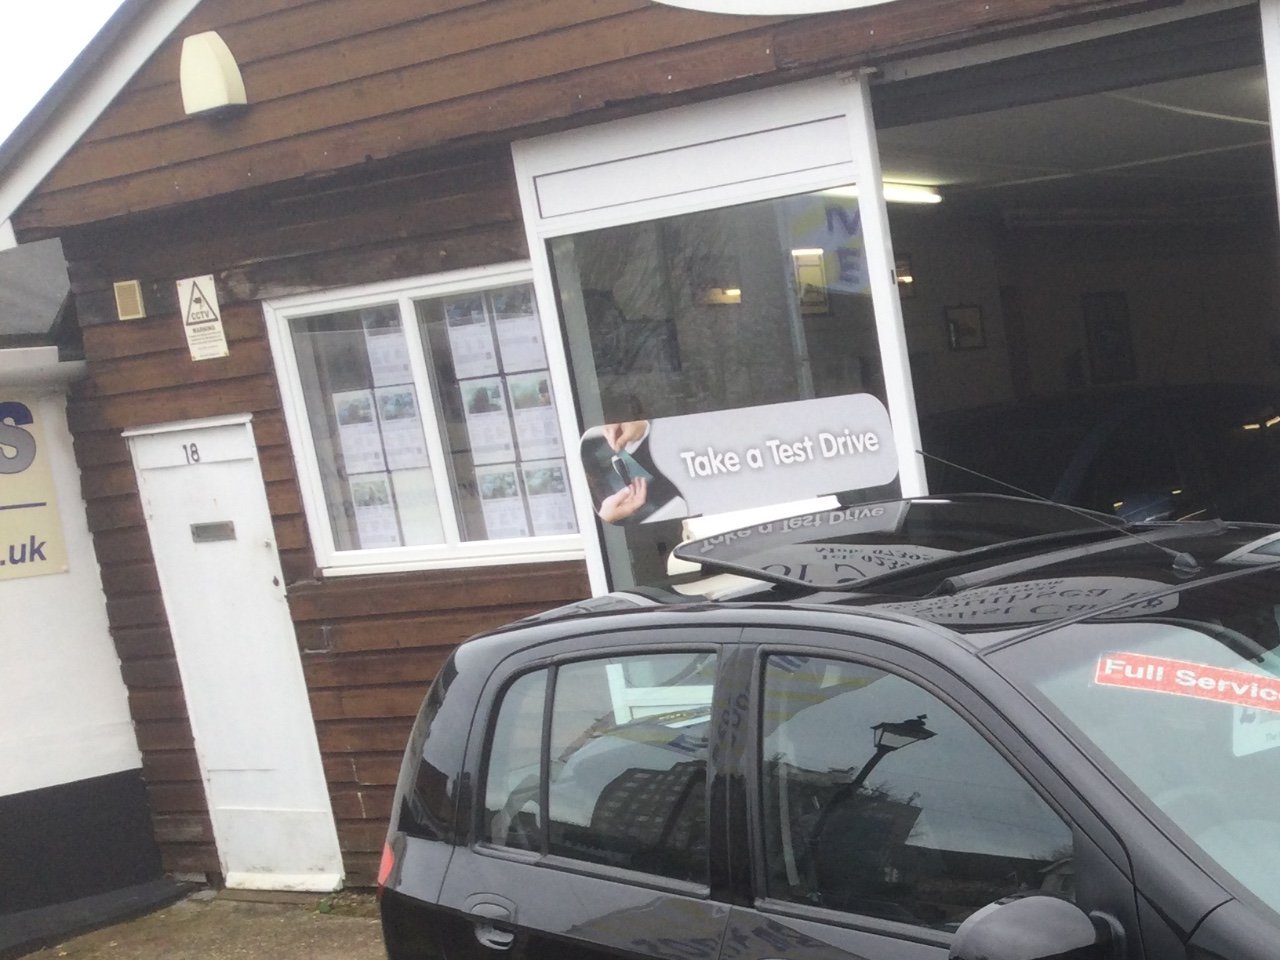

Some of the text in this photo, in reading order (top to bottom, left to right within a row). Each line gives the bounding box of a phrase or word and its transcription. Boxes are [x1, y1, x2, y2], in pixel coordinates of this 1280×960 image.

[191, 310, 210, 321] CCTV
[182, 443, 200, 465] 18
[680, 428, 880, 478] Take a Test Drive
[1104, 658, 1164, 682] Full
